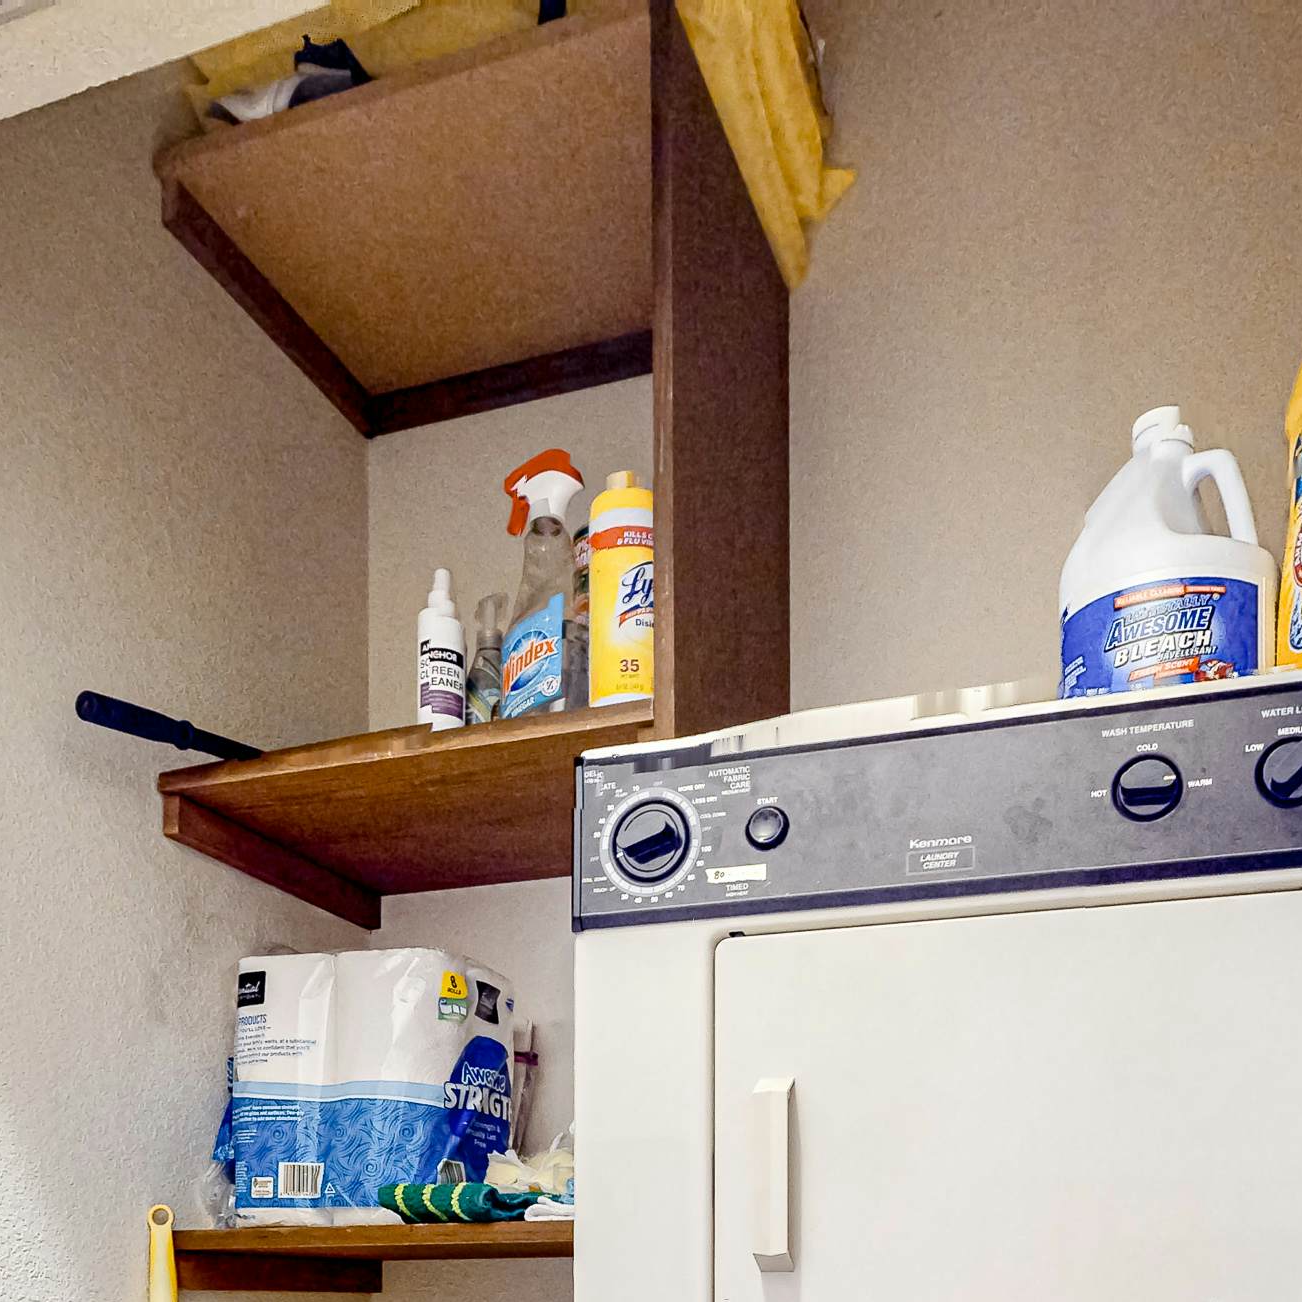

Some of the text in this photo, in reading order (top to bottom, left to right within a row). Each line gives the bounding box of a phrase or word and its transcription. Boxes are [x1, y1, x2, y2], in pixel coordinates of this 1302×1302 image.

[621, 567, 654, 604] Ly
[1104, 605, 1215, 653] AWESOME
[1114, 630, 1213, 668] BLEACH
[619, 659, 640, 673] 35
[1261, 708, 1294, 719] WATER
[1101, 719, 1195, 738] WASH TEMPERATURE
[1136, 743, 1158, 752] COLD
[1245, 743, 1265, 753] LOW
[708, 766, 751, 778] AUTOMATIC
[723, 774, 751, 783] FABRIC
[1187, 778, 1213, 788] WARM
[730, 781, 751, 790] CARE
[1091, 790, 1108, 798] HOT
[756, 796, 779, 805] START
[909, 835, 972, 850] Kenmore
[701, 845, 712, 853] 100
[920, 851, 961, 863] LAUNDRY
[922, 859, 957, 870] CENTER
[725, 883, 749, 892] TIMED
[450, 975, 458, 989] 8
[239, 1013, 267, 1025] PRODUCTS
